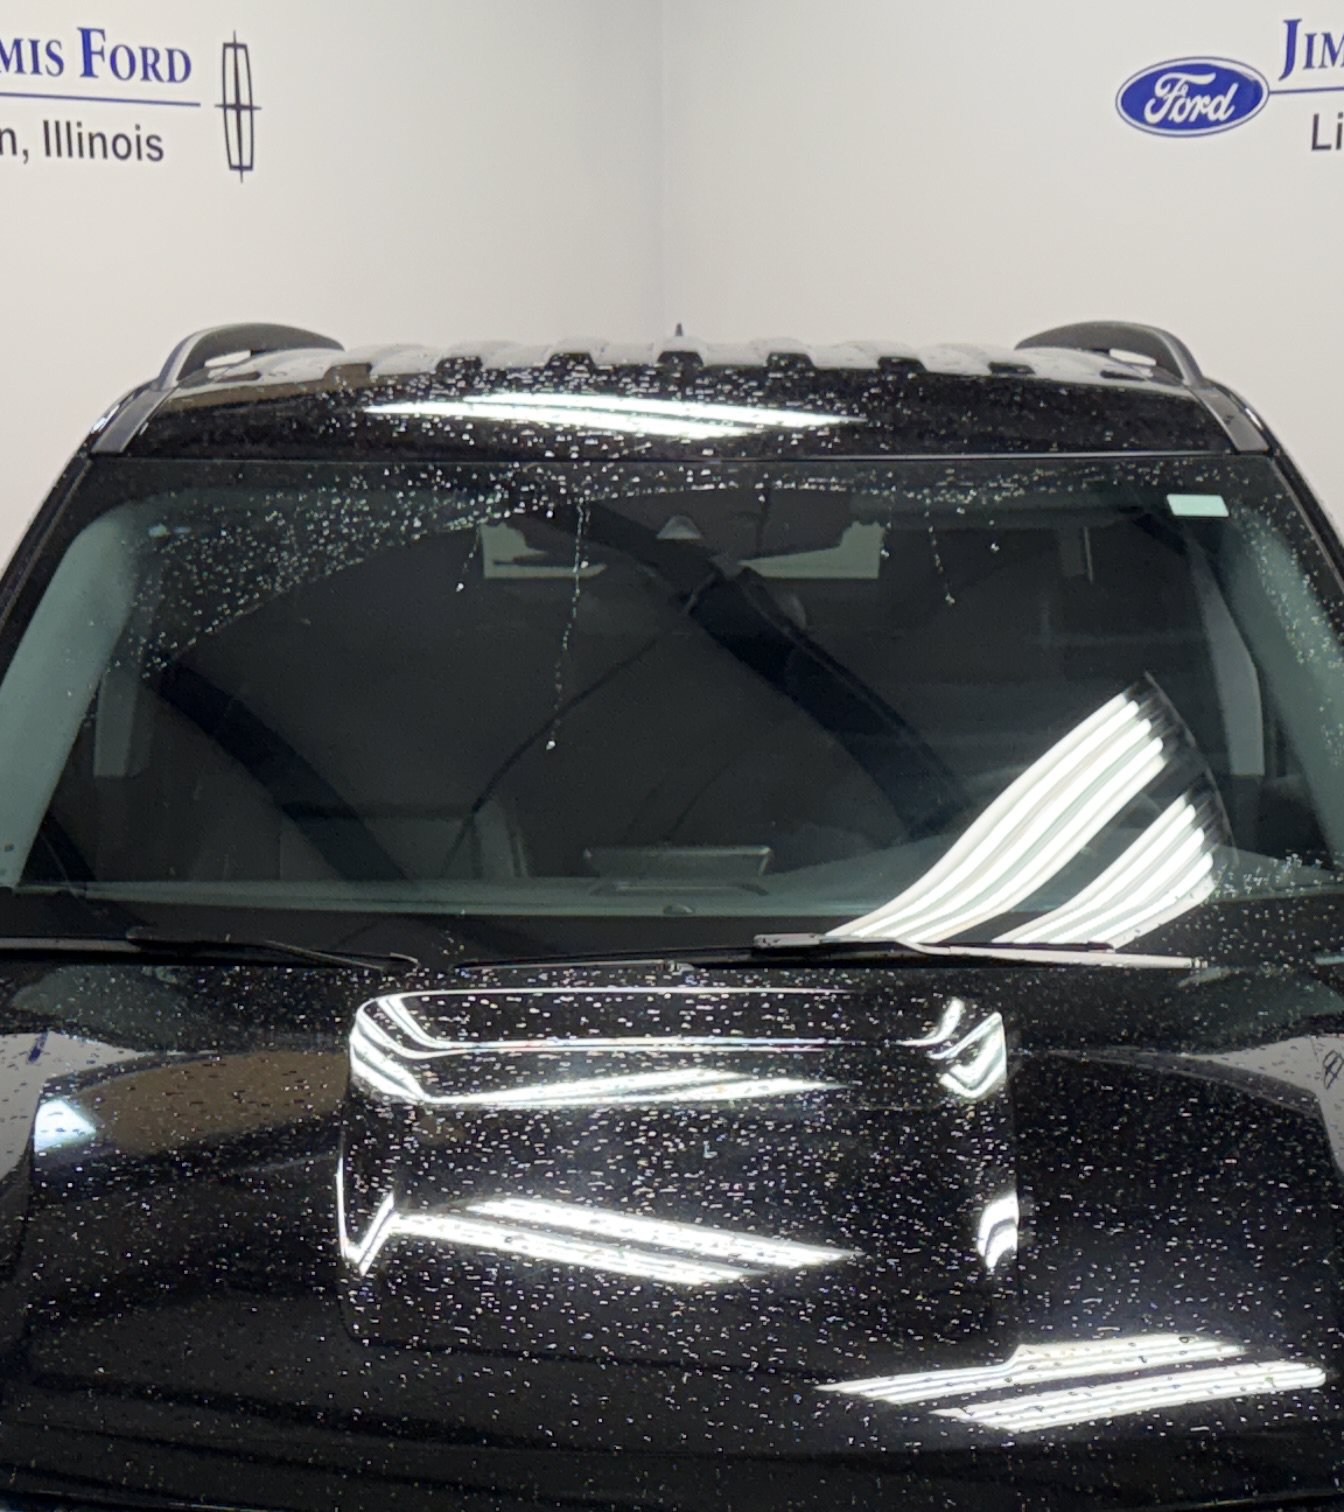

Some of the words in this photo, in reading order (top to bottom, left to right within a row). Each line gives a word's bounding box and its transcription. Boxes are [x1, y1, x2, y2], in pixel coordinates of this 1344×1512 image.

[78, 28, 191, 82] FORD
[1144, 73, 1234, 124] Ford
[43, 120, 163, 161] Illinois
